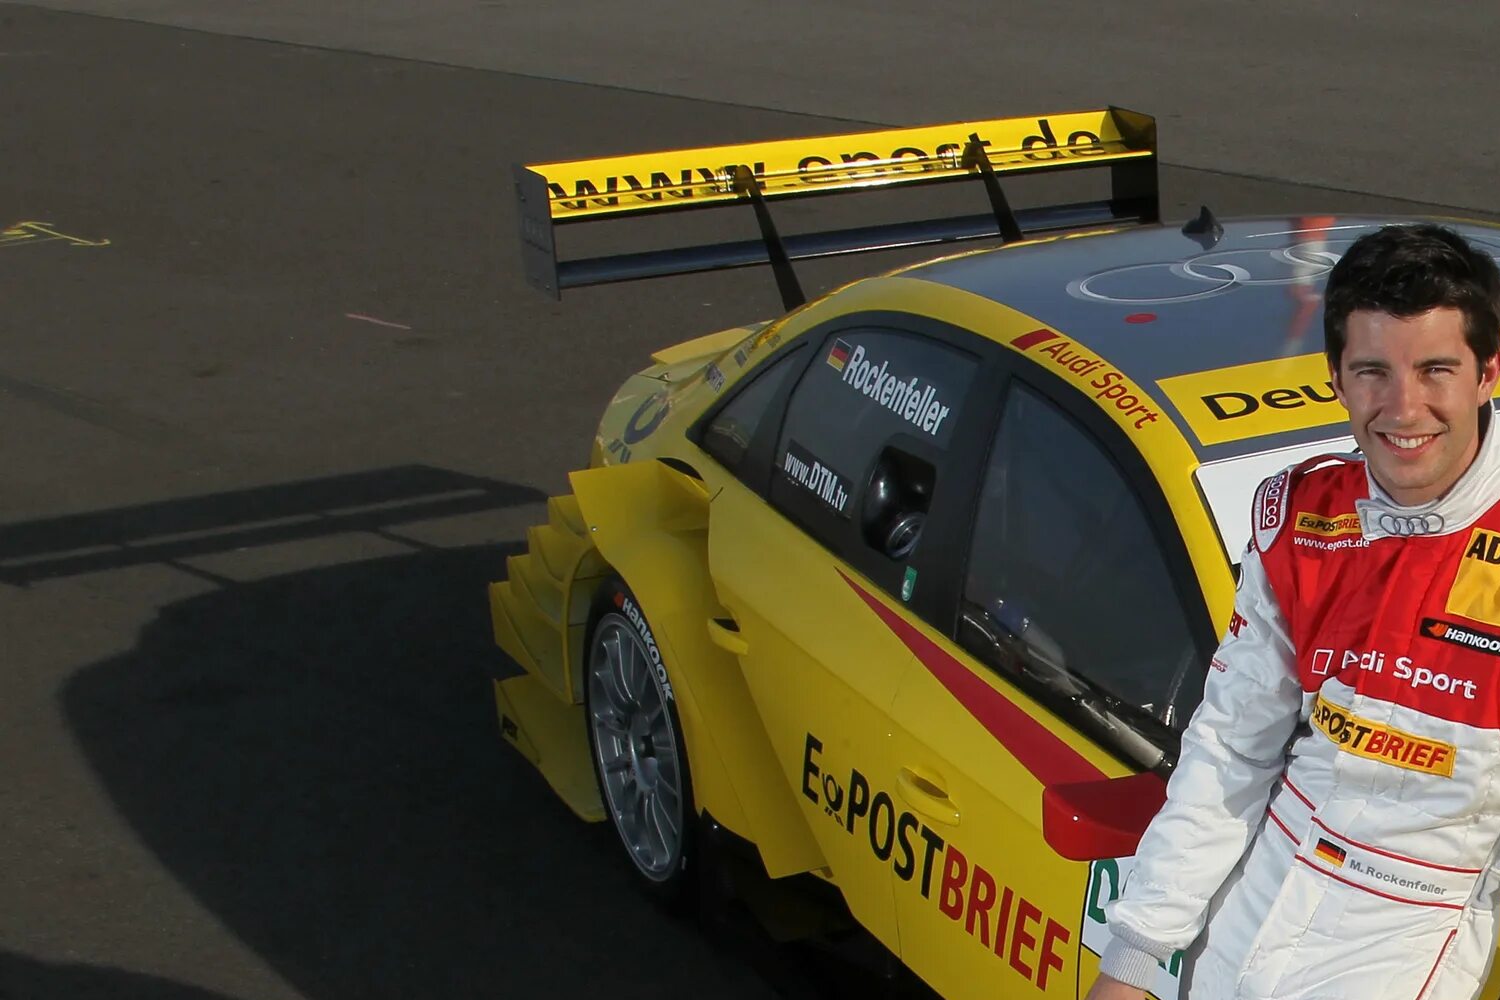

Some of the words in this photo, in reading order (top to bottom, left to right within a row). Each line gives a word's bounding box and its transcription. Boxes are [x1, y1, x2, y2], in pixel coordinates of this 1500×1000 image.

[842, 345, 950, 436] Rockenfeller
[1039, 340, 1102, 377] Audi
[1091, 372, 1159, 430] Sport
[784, 450, 848, 512] www.DTM.tv
[1294, 536, 1370, 552] www.epost.de
[1393, 657, 1477, 699] Sport
